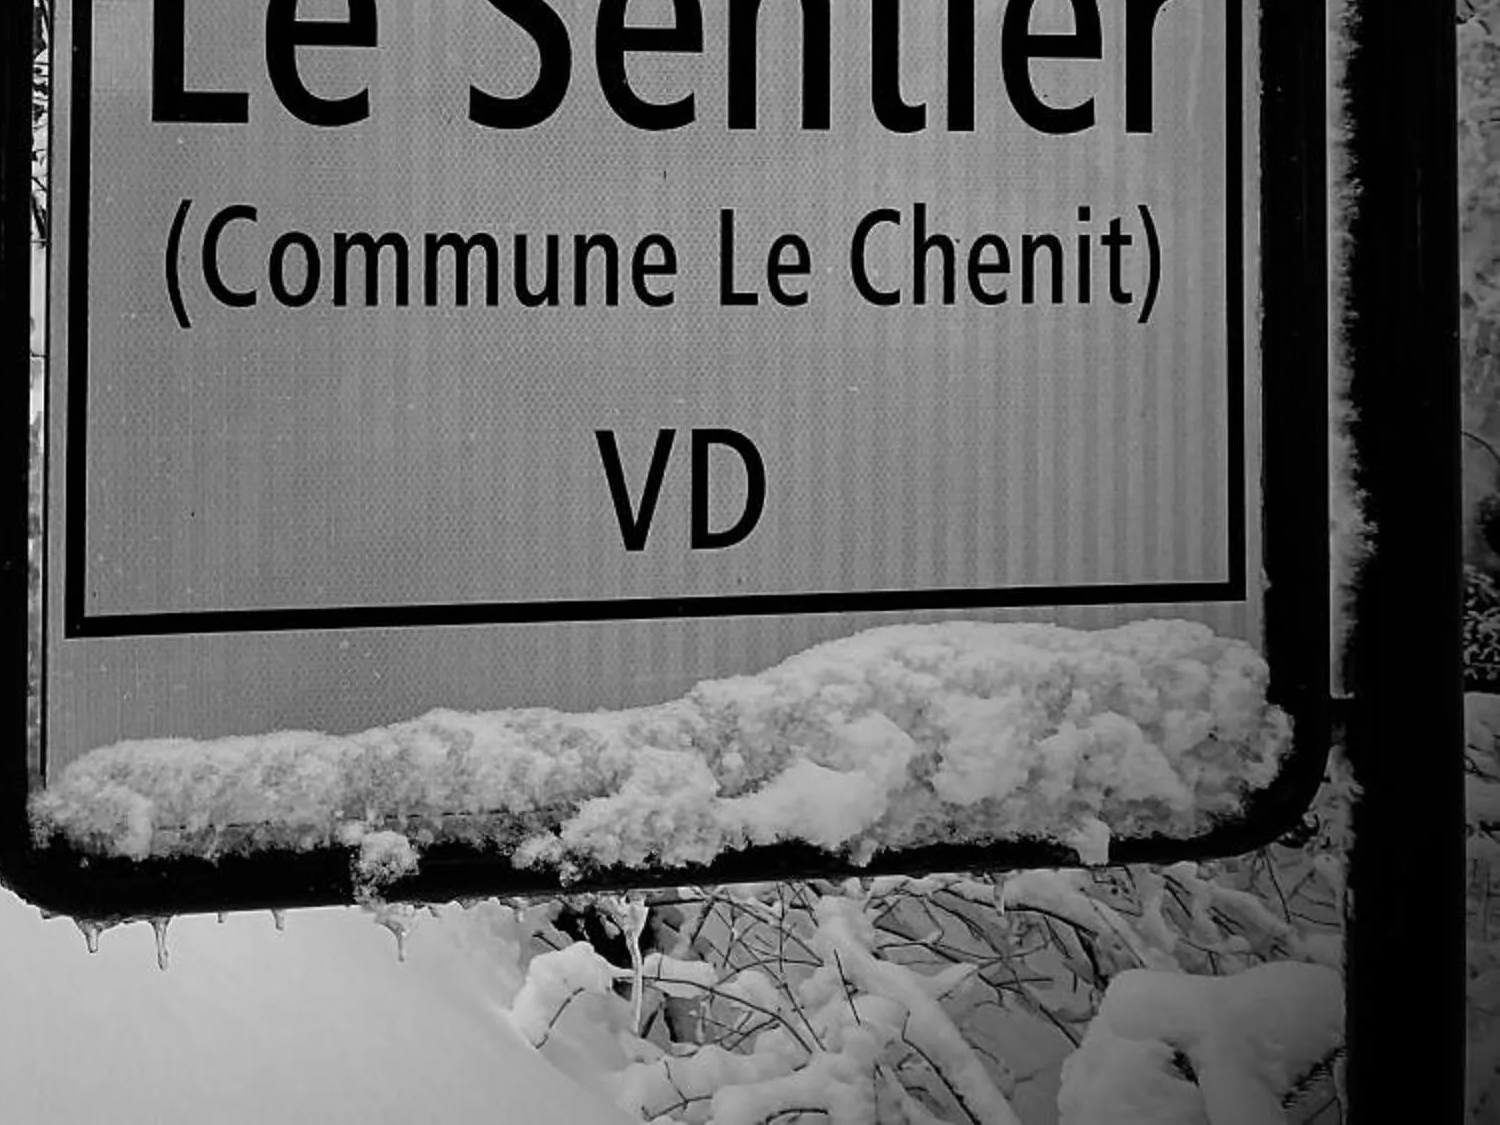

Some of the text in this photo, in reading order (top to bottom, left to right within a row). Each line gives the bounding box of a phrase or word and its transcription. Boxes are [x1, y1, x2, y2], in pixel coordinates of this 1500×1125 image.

[166, 200, 1161, 329] (Commune Le Chenit)
[595, 428, 766, 552] VD
